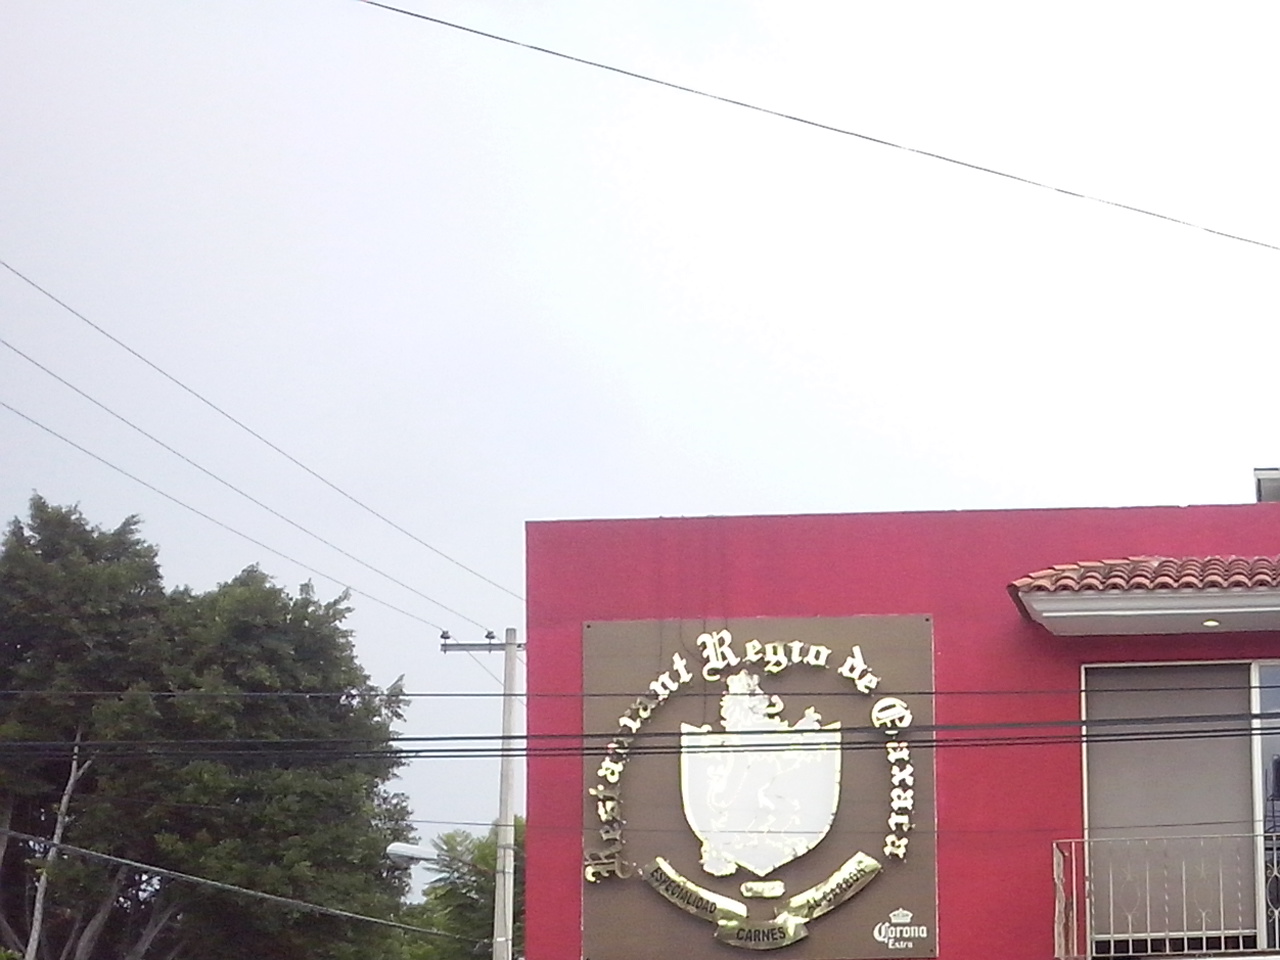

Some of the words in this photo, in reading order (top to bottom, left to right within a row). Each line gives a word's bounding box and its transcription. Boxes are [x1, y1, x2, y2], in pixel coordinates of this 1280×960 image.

[696, 629, 832, 682] Regio
[837, 645, 882, 695] de
[650, 867, 718, 915] ESPECIALIDAD
[736, 925, 786, 943] CARNES
[872, 922, 928, 944] Corona
[888, 939, 913, 949] Extra
